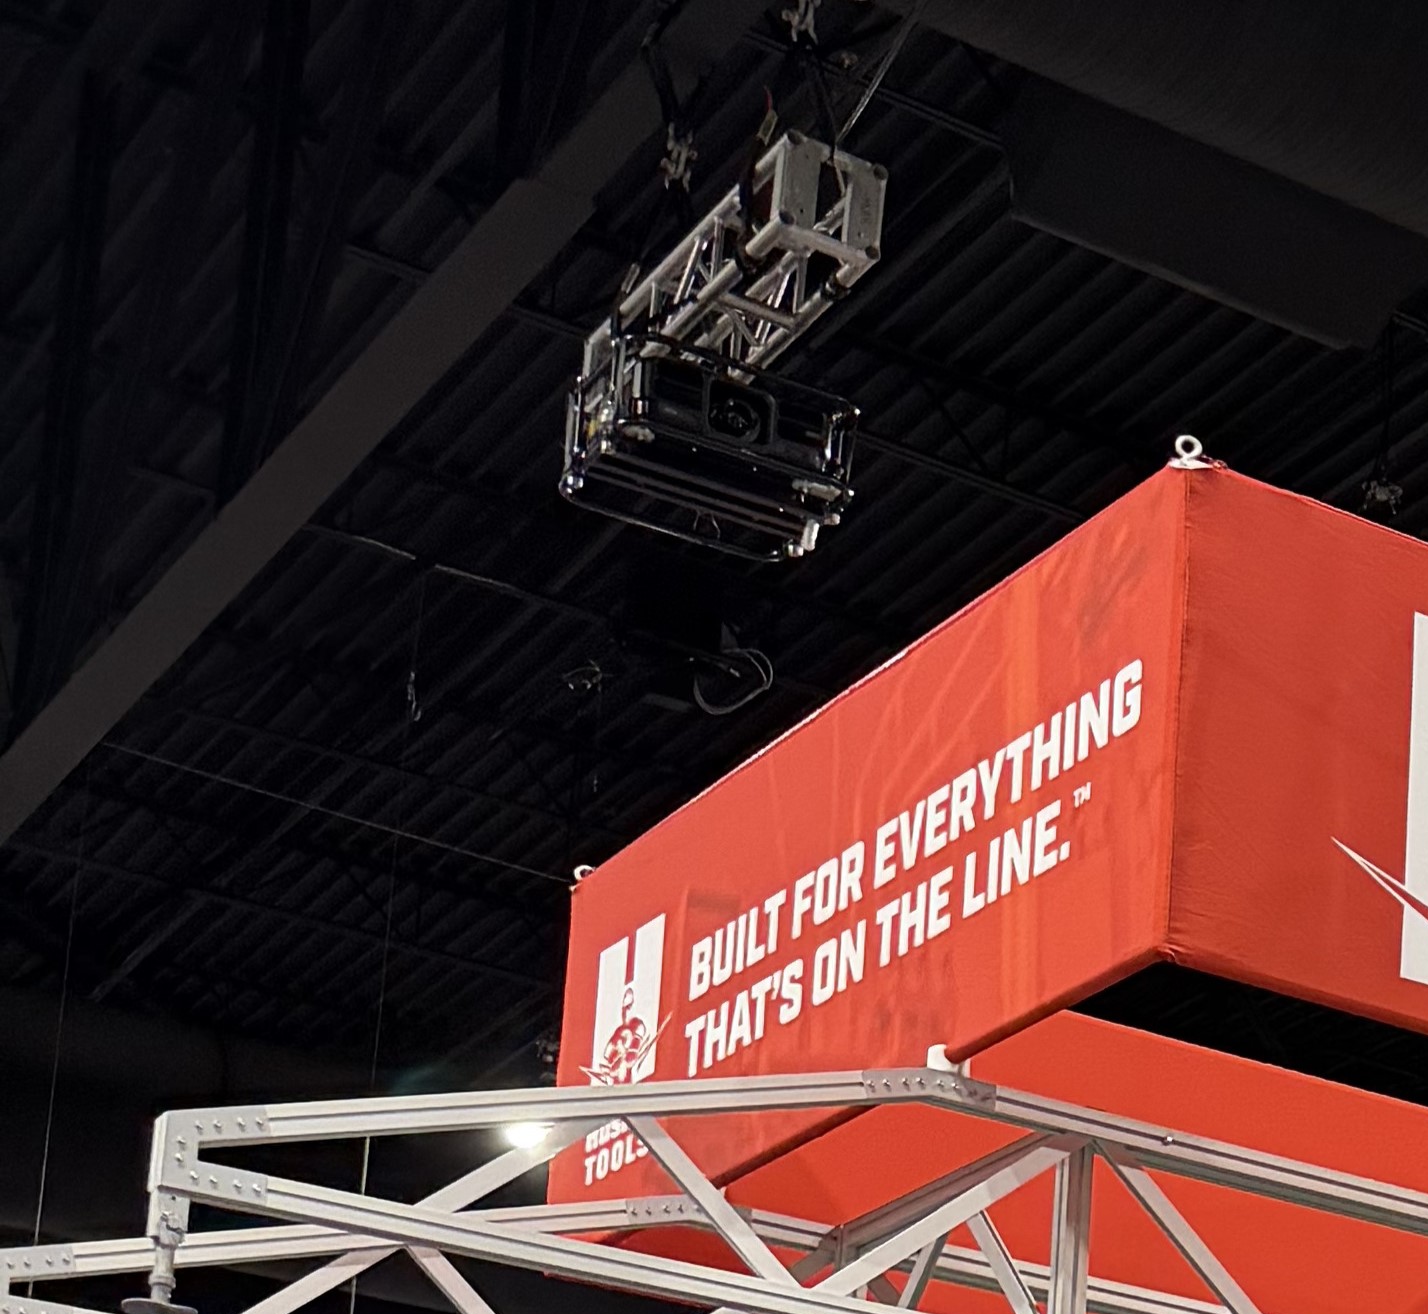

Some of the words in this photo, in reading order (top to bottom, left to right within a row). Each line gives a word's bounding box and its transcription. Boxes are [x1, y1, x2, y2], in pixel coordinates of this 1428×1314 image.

[688, 889, 787, 1001] BUILT
[791, 841, 865, 939] FOR
[873, 659, 1143, 889] EVERYTHING
[684, 958, 804, 1078] THAT'S
[812, 919, 866, 1006] ON
[875, 866, 953, 967] THE
